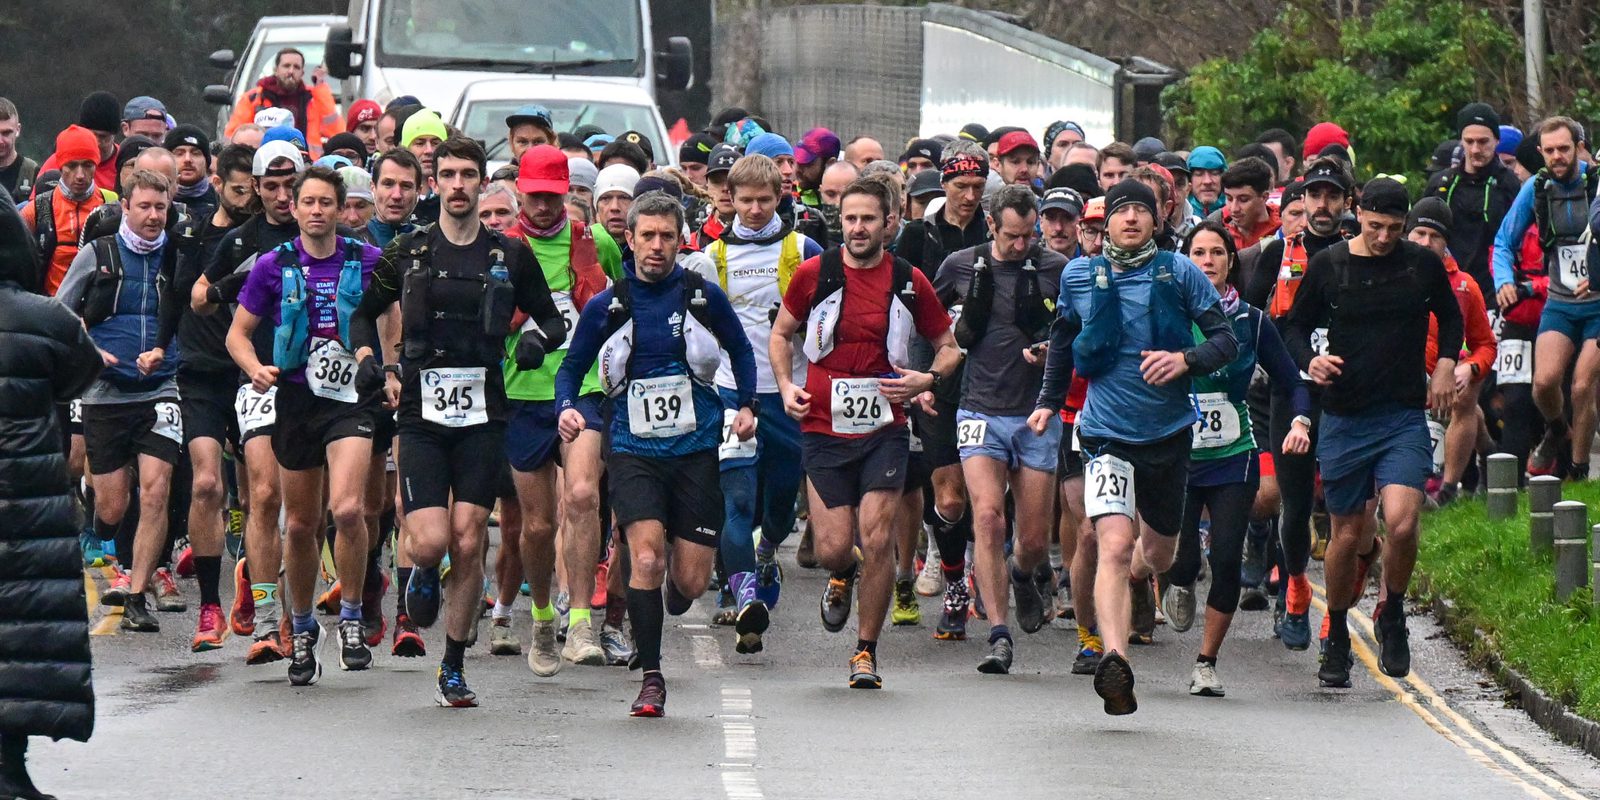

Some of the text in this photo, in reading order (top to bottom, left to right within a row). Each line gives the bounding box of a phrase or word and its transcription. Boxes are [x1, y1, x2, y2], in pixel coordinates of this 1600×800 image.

[315, 357, 353, 385] 386
[241, 396, 273, 419] 476
[434, 386, 473, 411] 345
[643, 394, 682, 422] 139
[842, 396, 881, 419] 326
[1095, 473, 1128, 498] 237
